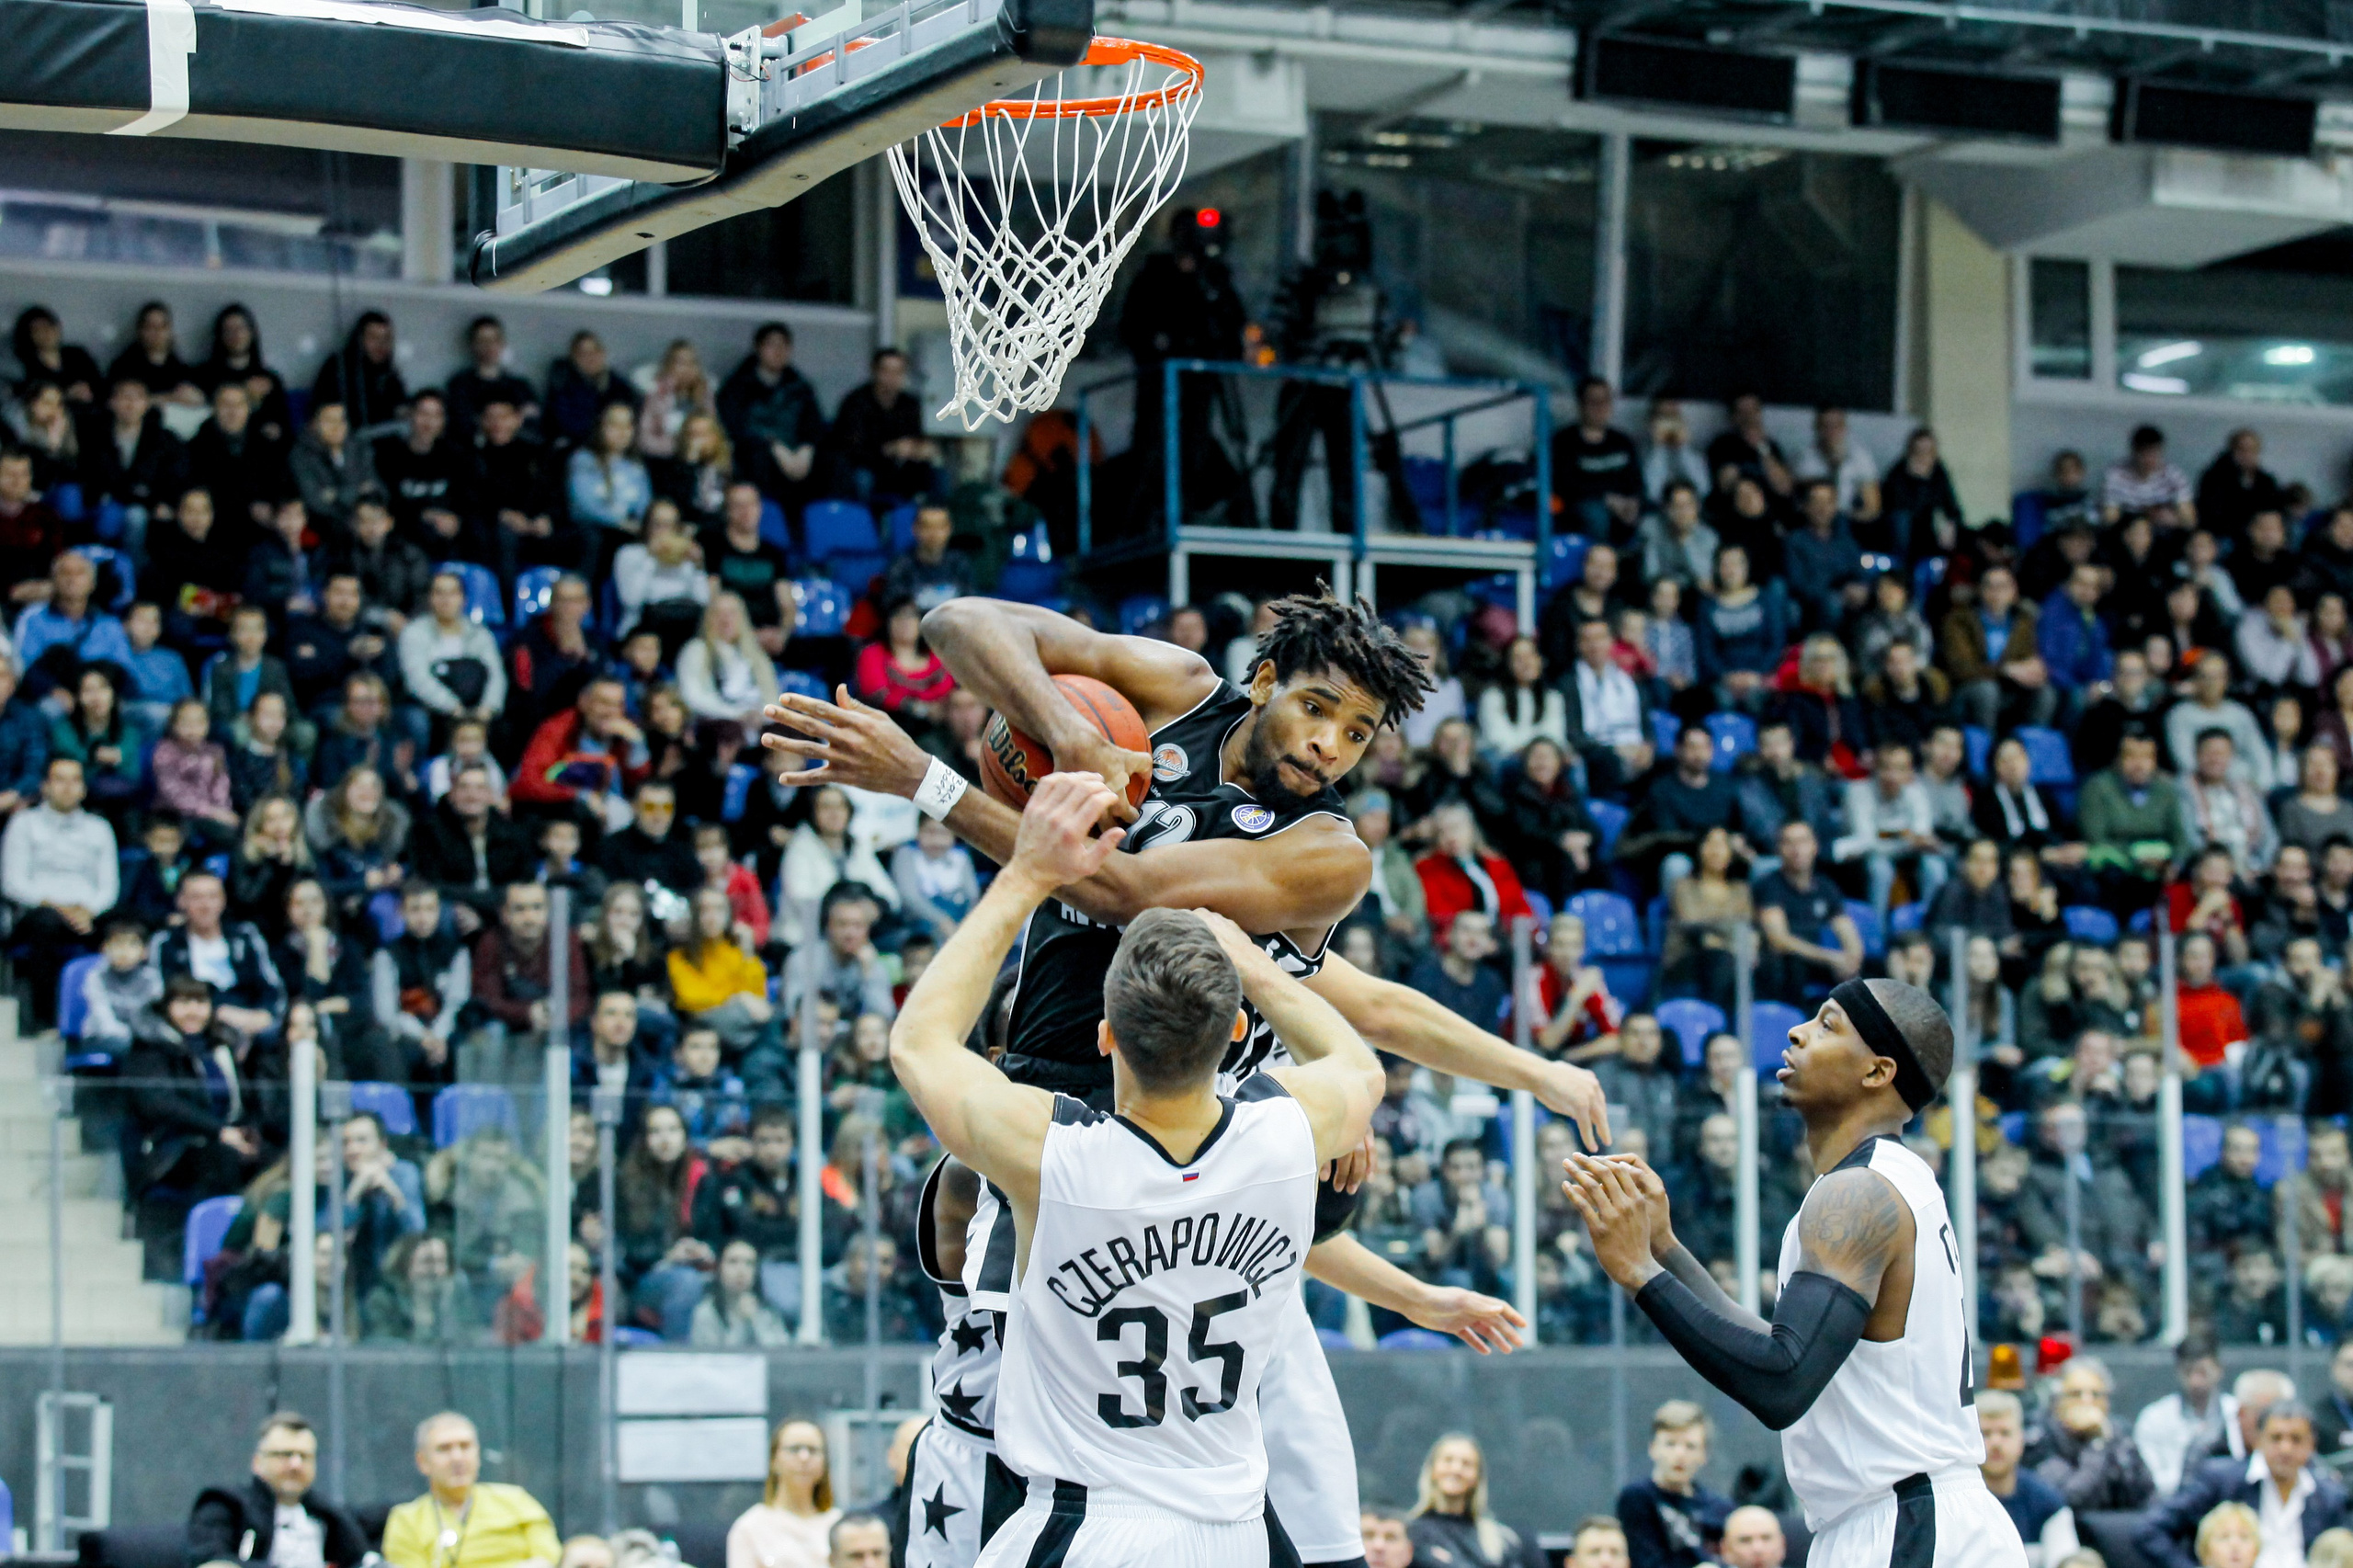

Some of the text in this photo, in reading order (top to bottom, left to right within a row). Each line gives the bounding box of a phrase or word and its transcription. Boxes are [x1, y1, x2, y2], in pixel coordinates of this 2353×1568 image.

[987, 711, 1040, 796] Wilso
[1046, 1211, 1297, 1318] CZERAPOWICZ
[1097, 1288, 1248, 1428] 35
